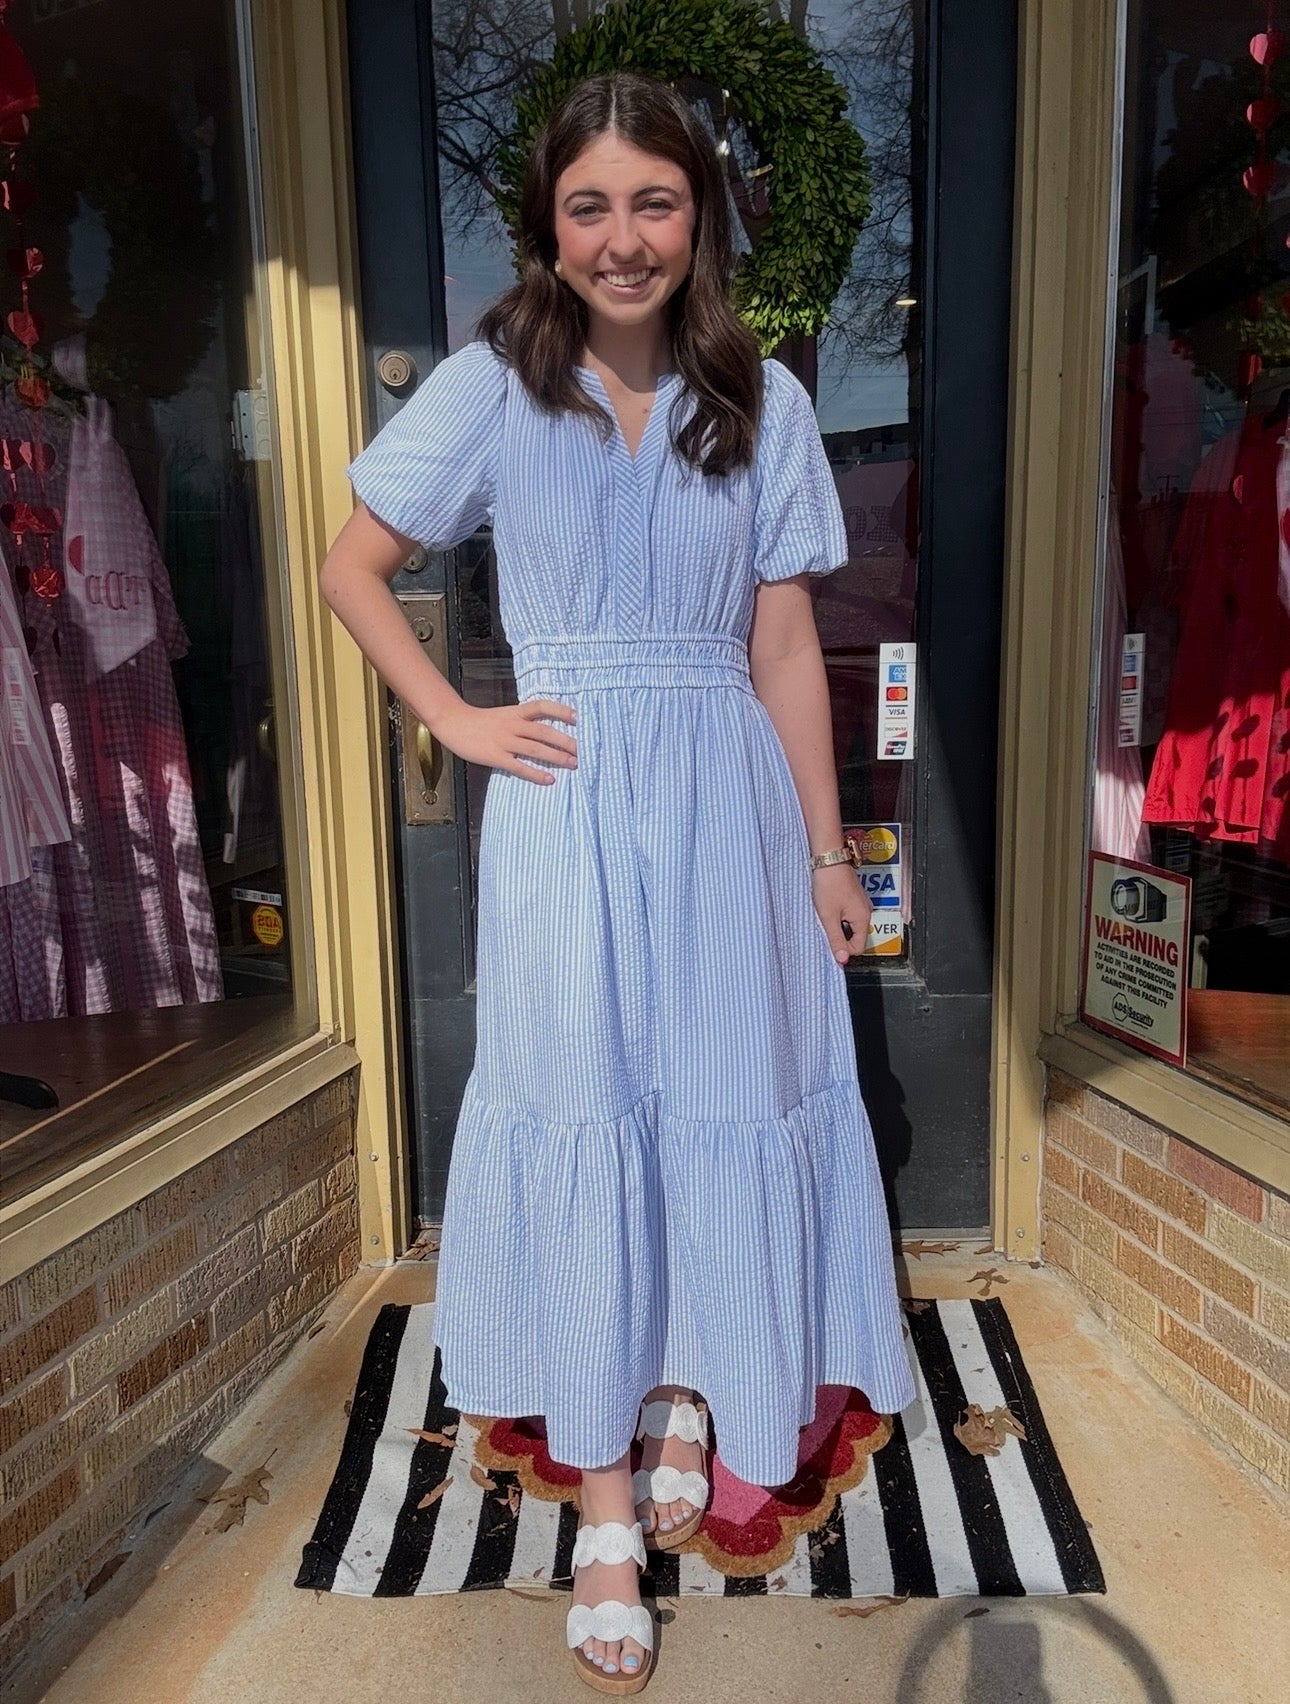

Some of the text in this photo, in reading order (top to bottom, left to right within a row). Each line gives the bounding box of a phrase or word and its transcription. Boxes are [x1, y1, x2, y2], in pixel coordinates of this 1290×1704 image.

[857, 874, 896, 892] ISA
[1095, 915, 1178, 967] WARNING
[1095, 951, 1177, 991] TO AID IN THE PROSECUTION
[1097, 942, 1174, 978] ACTIVITIES ARE RECORDED
[1096, 962, 1174, 1001] OF ANY CRIME COMMITTED
[1101, 975, 1168, 1009] AGAINST THIS FACILITY
[1114, 1001, 1127, 1014] ADS
[1128, 1007, 1154, 1027] Security
